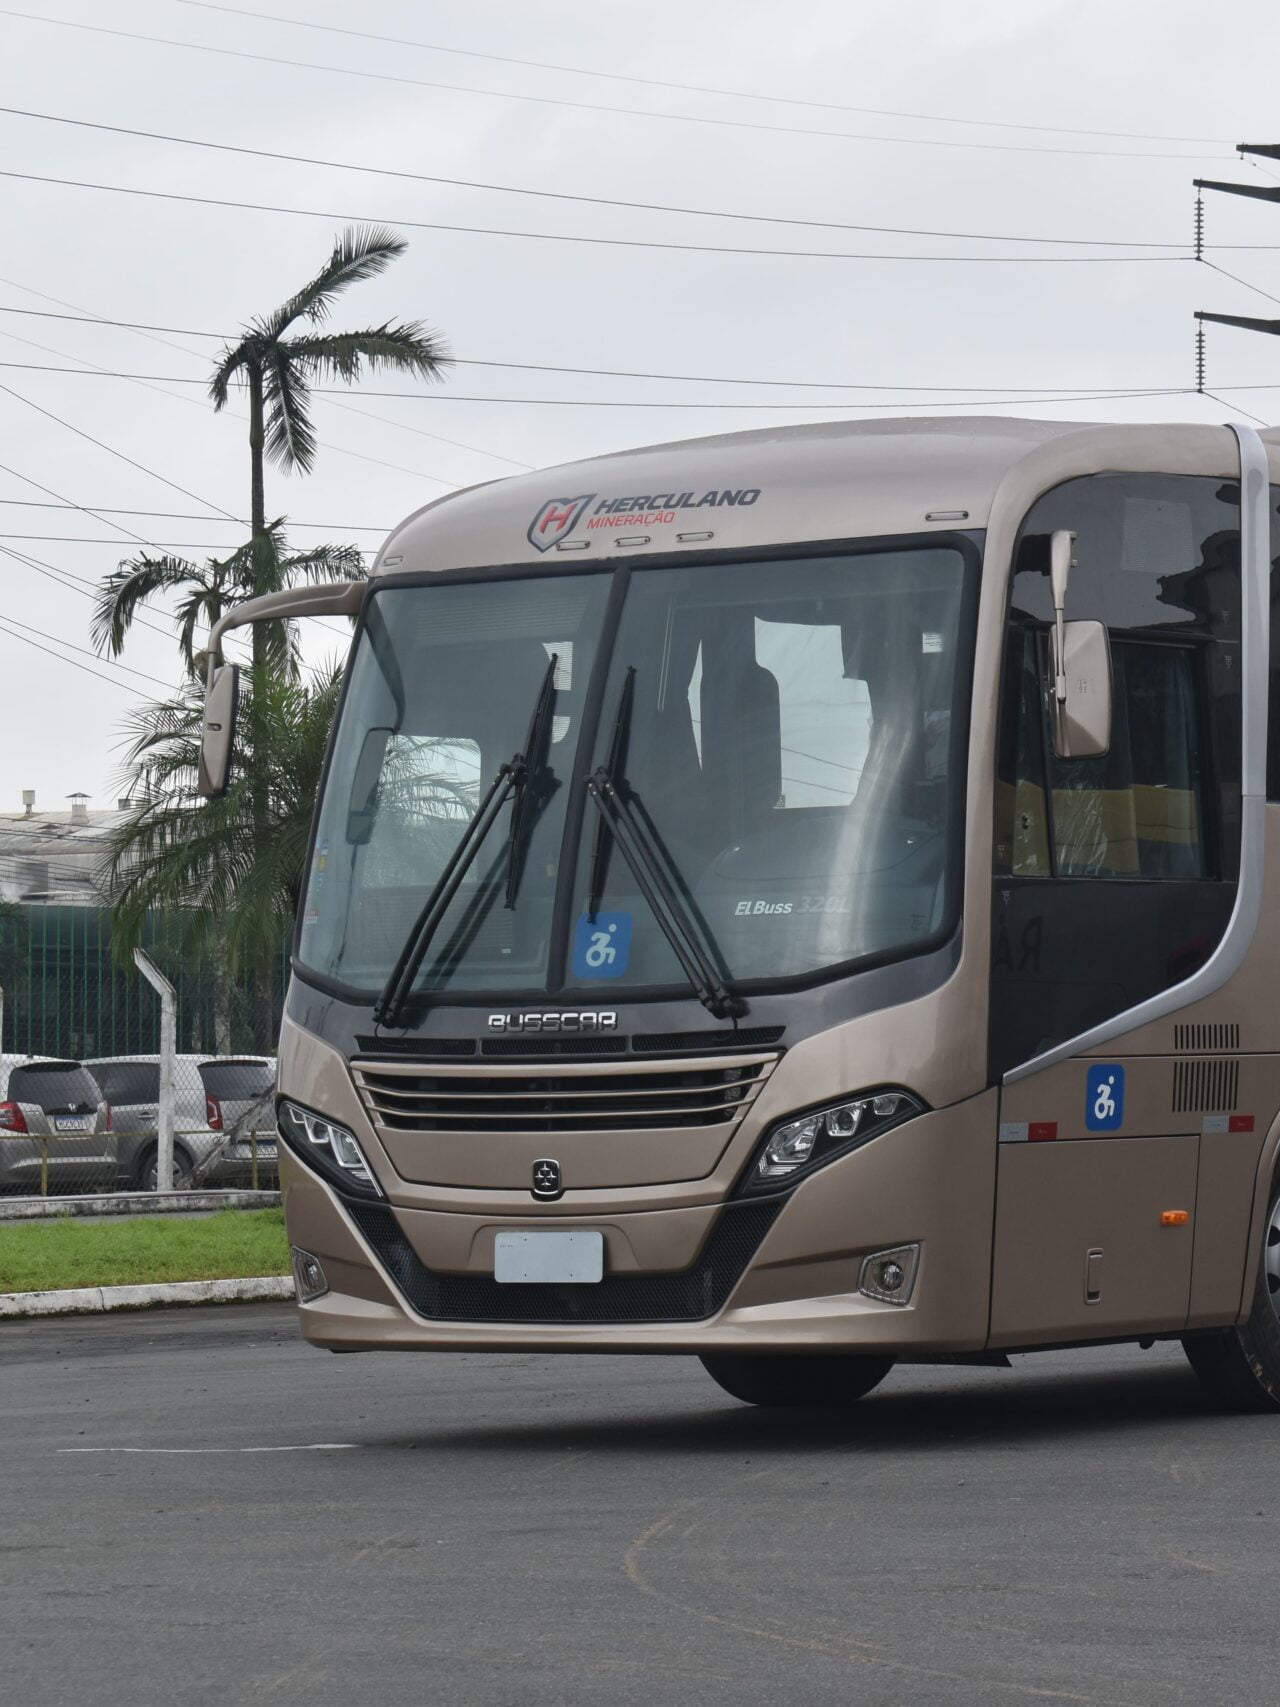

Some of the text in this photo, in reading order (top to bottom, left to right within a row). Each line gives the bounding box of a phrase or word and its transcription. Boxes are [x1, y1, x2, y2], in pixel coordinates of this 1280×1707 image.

[593, 488, 762, 515] HERCULANO
[587, 510, 676, 530] MINERAÇÃO
[487, 1011, 617, 1032] BUSSCAR
